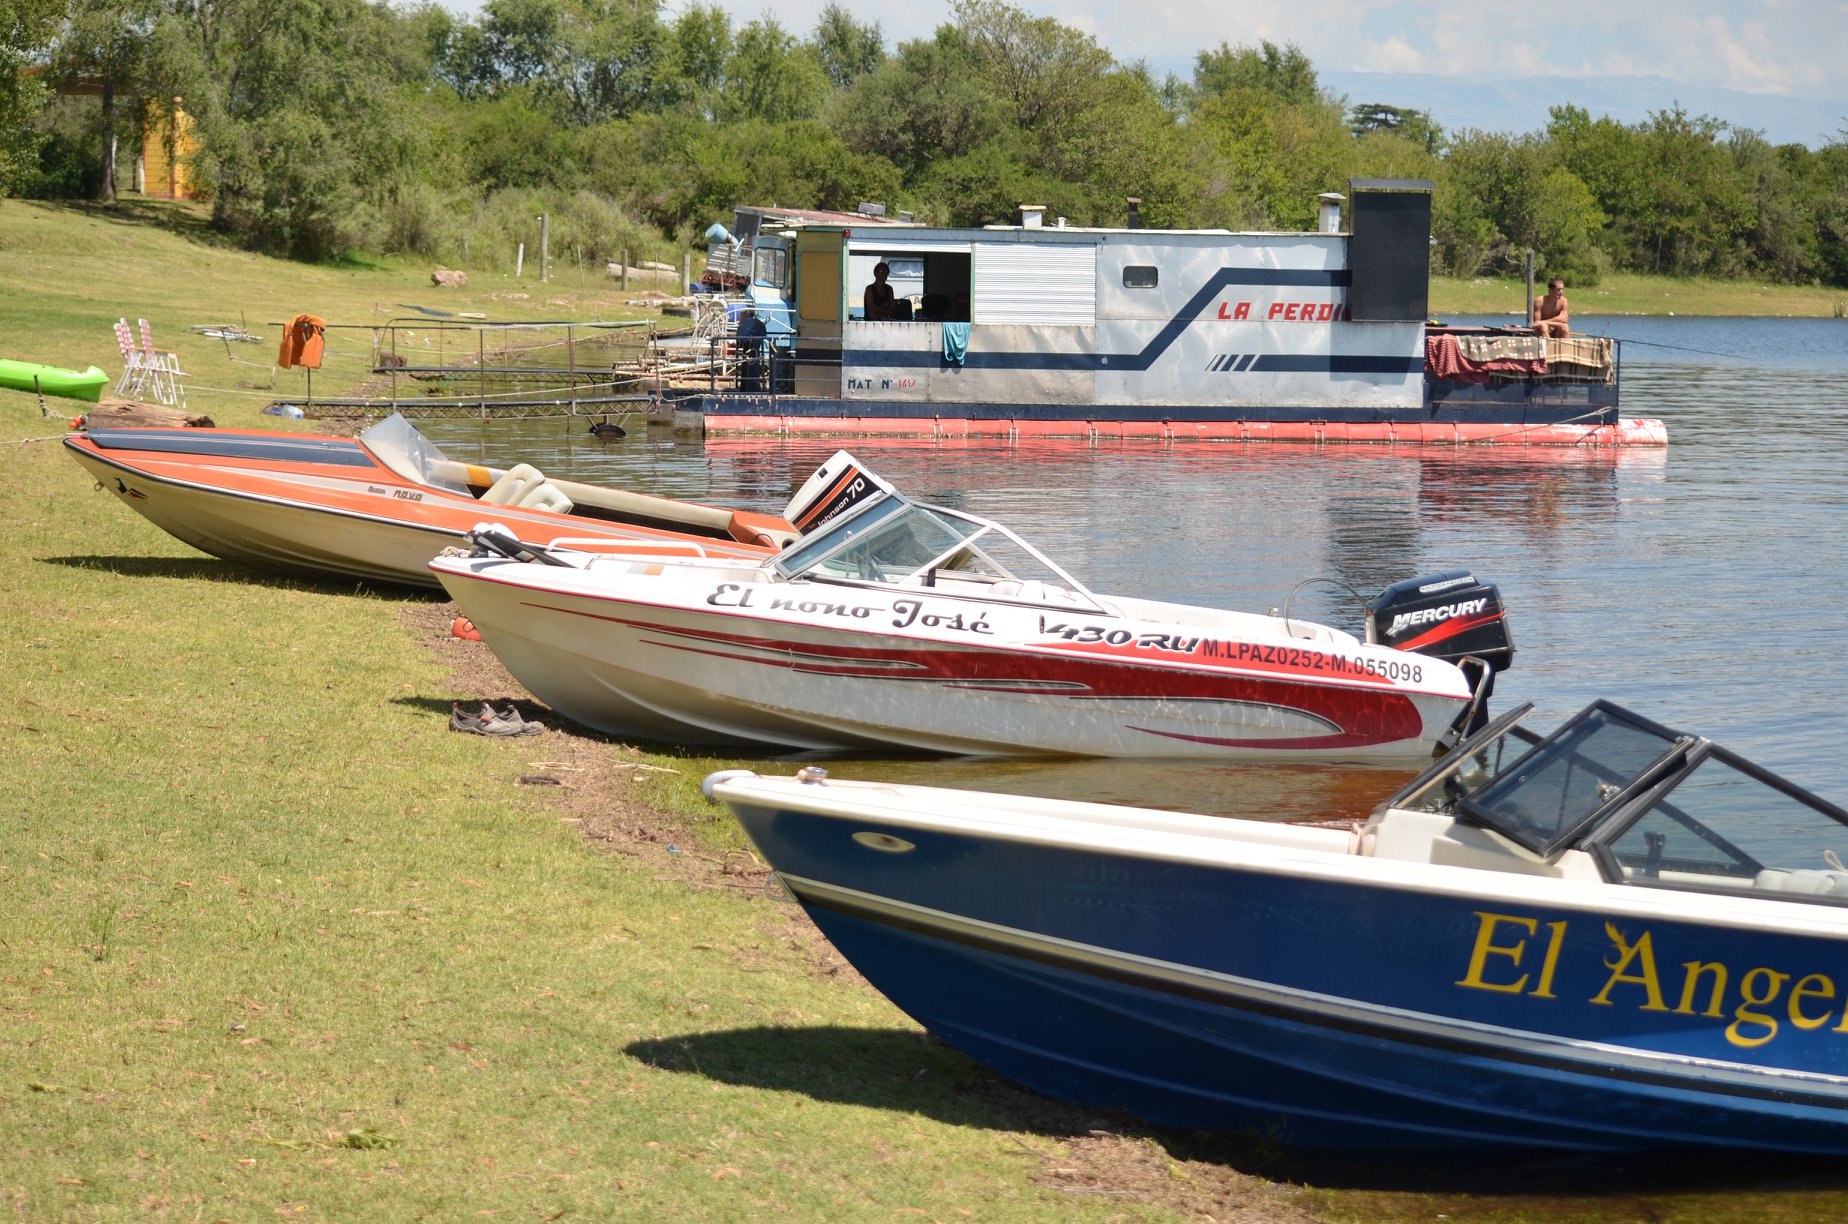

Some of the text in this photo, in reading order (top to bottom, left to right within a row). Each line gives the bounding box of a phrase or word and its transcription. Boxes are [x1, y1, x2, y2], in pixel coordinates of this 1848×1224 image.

[1218, 302, 1251, 320] LA
[846, 477, 866, 499] 70
[706, 584, 995, 635] El nono José
[1391, 597, 1488, 631] MERCURY
[1454, 910, 1568, 999] El
